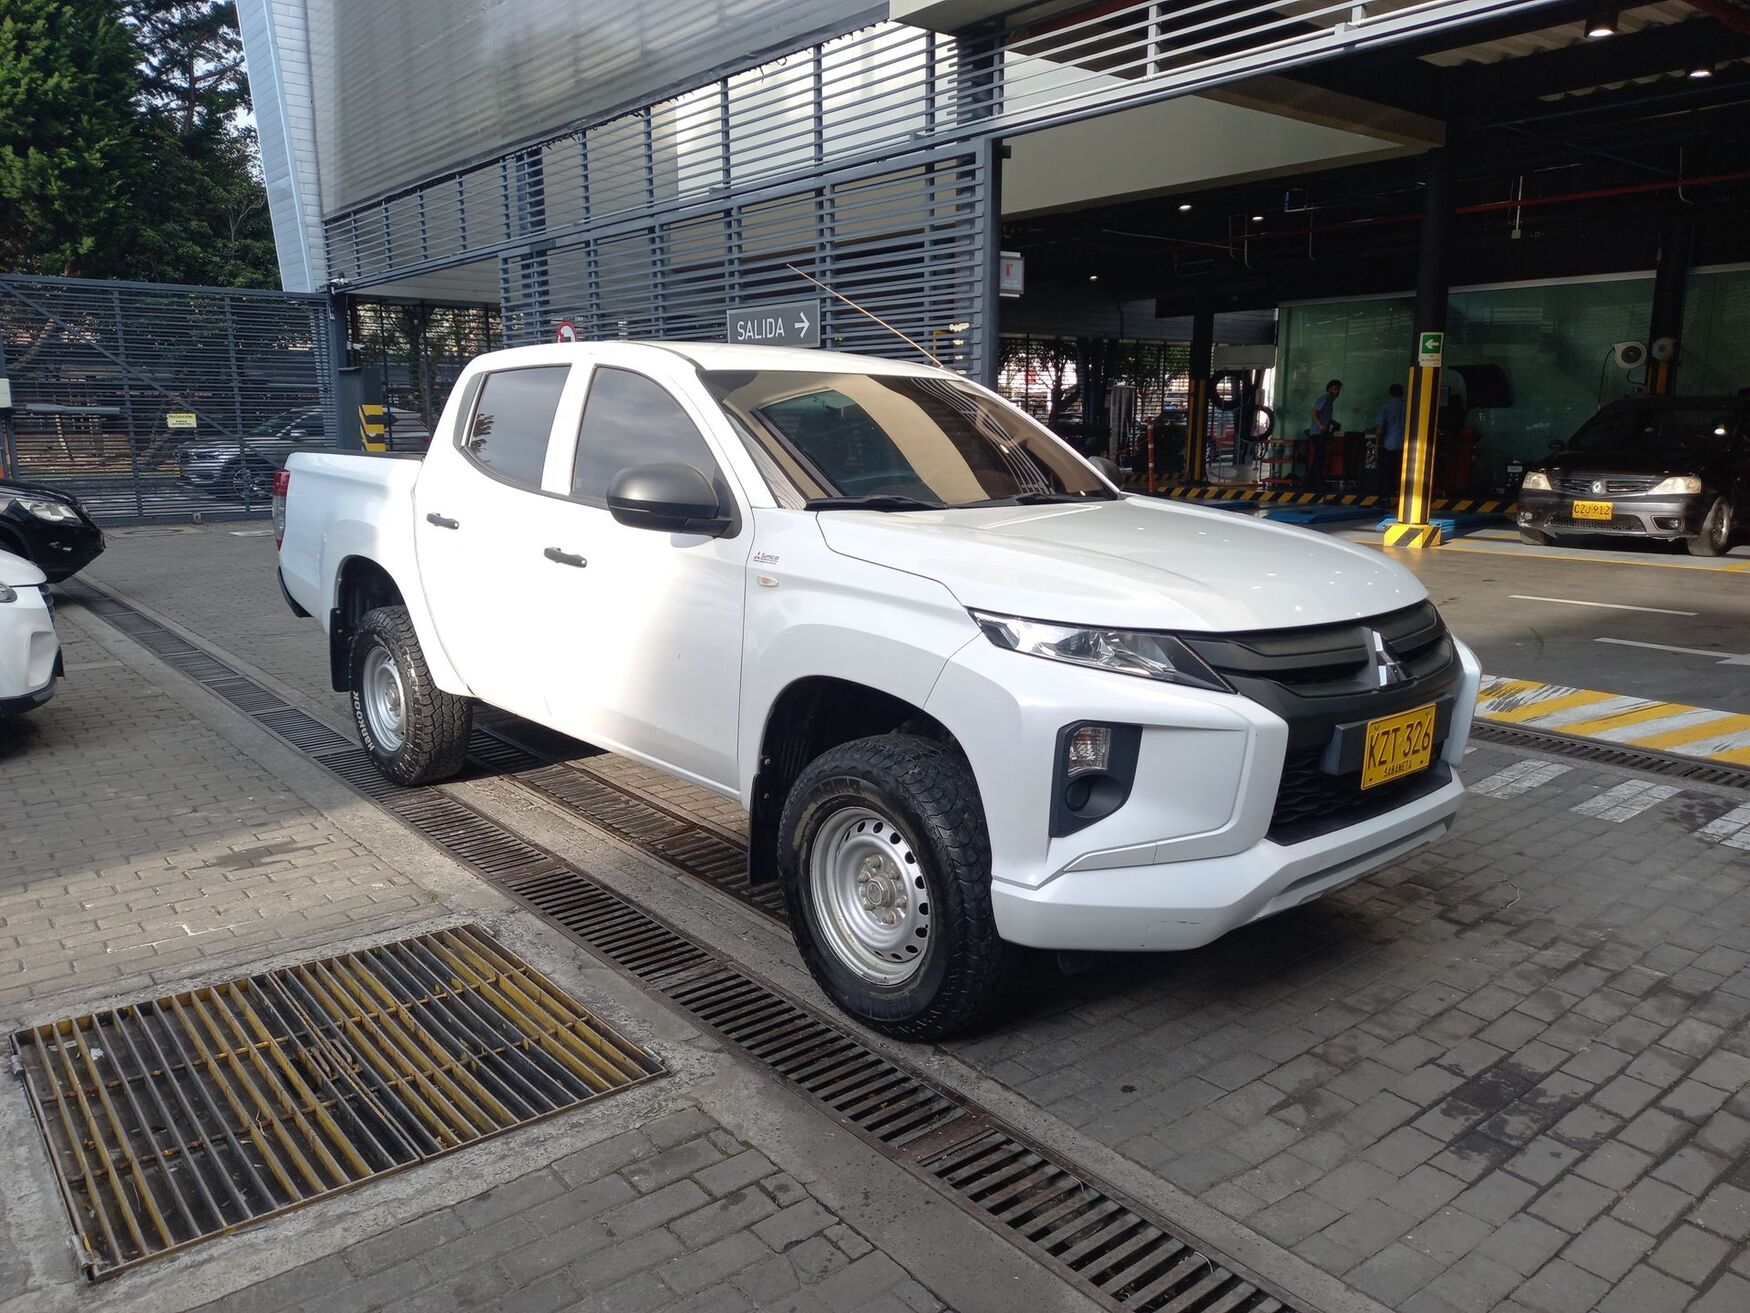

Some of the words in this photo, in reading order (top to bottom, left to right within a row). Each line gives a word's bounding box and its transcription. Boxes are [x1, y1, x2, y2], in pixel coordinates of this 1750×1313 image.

[737, 317, 785, 341] SALIDA
[1367, 726, 1400, 770] KZT
[1403, 716, 1432, 757] 326
